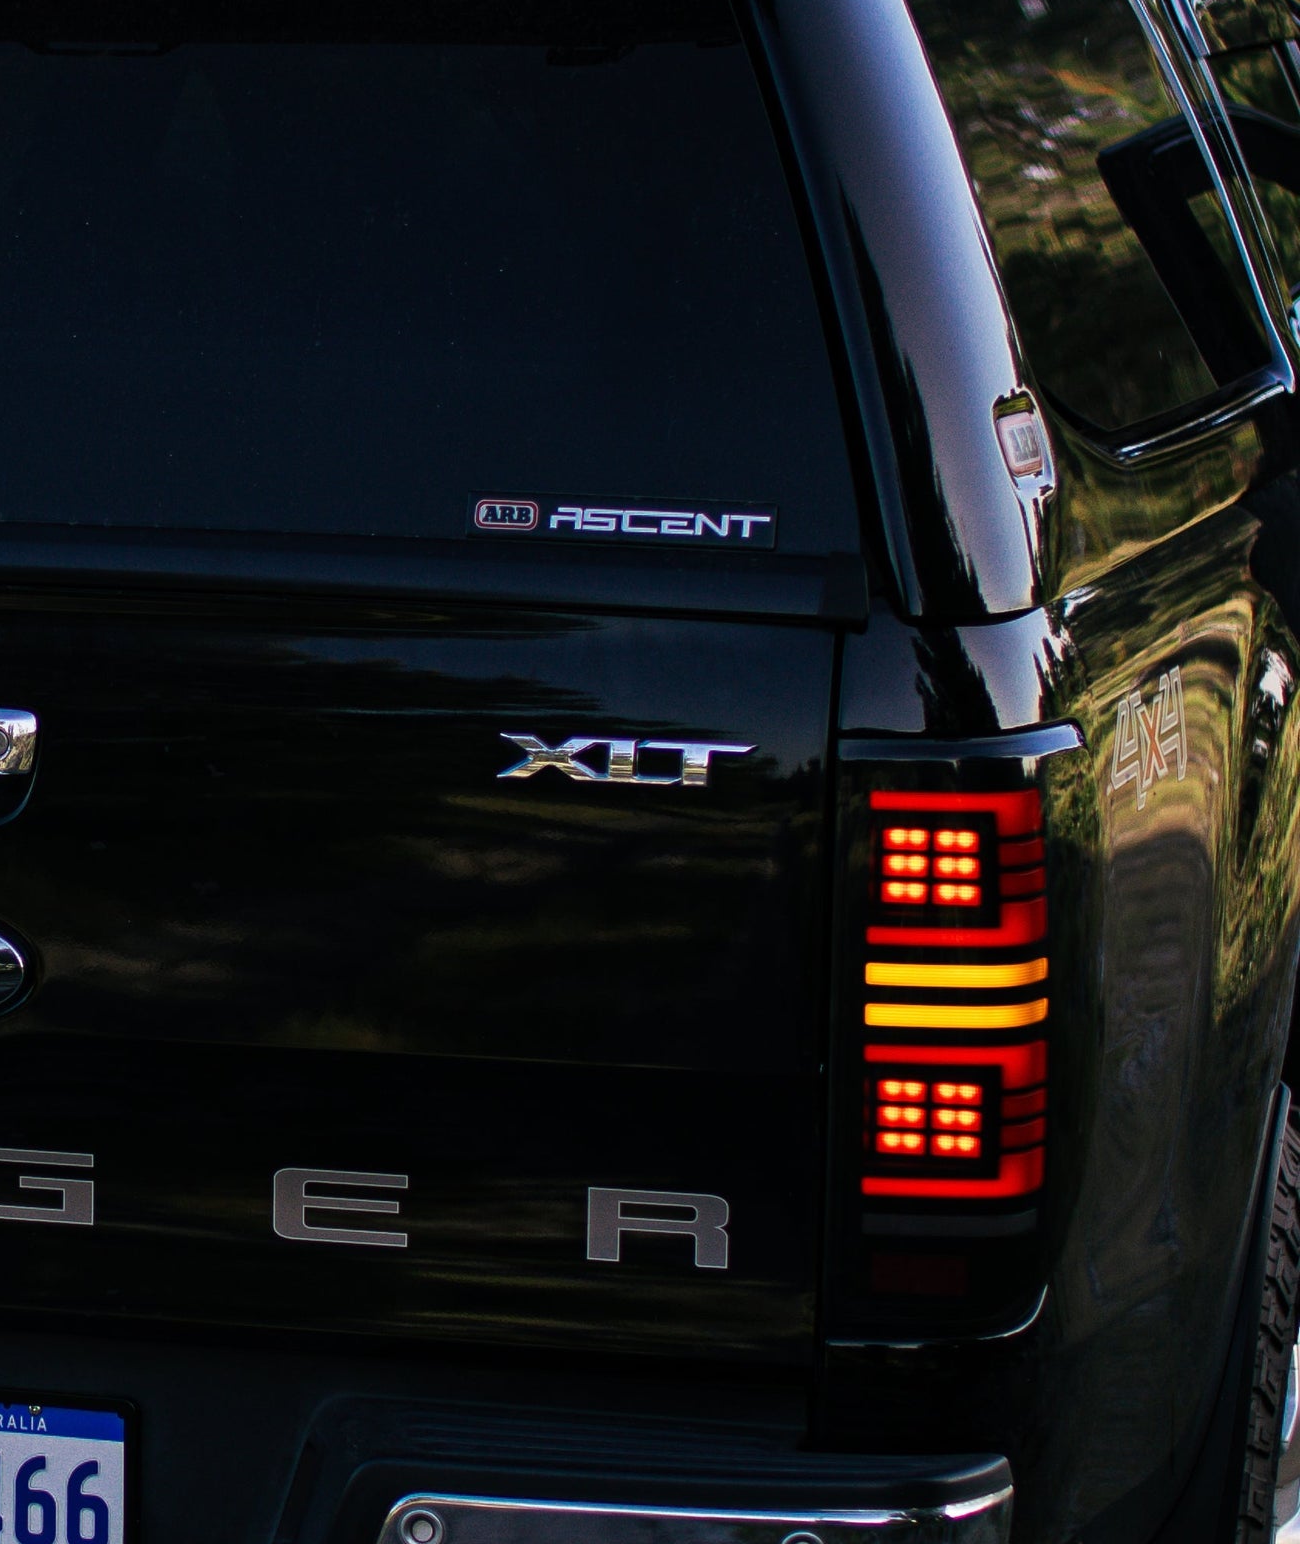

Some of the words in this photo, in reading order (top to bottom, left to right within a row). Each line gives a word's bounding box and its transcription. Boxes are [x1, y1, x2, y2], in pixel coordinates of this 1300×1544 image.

[479, 503, 533, 524] ARB
[549, 506, 770, 538] ASCENT
[496, 732, 759, 786] XLT
